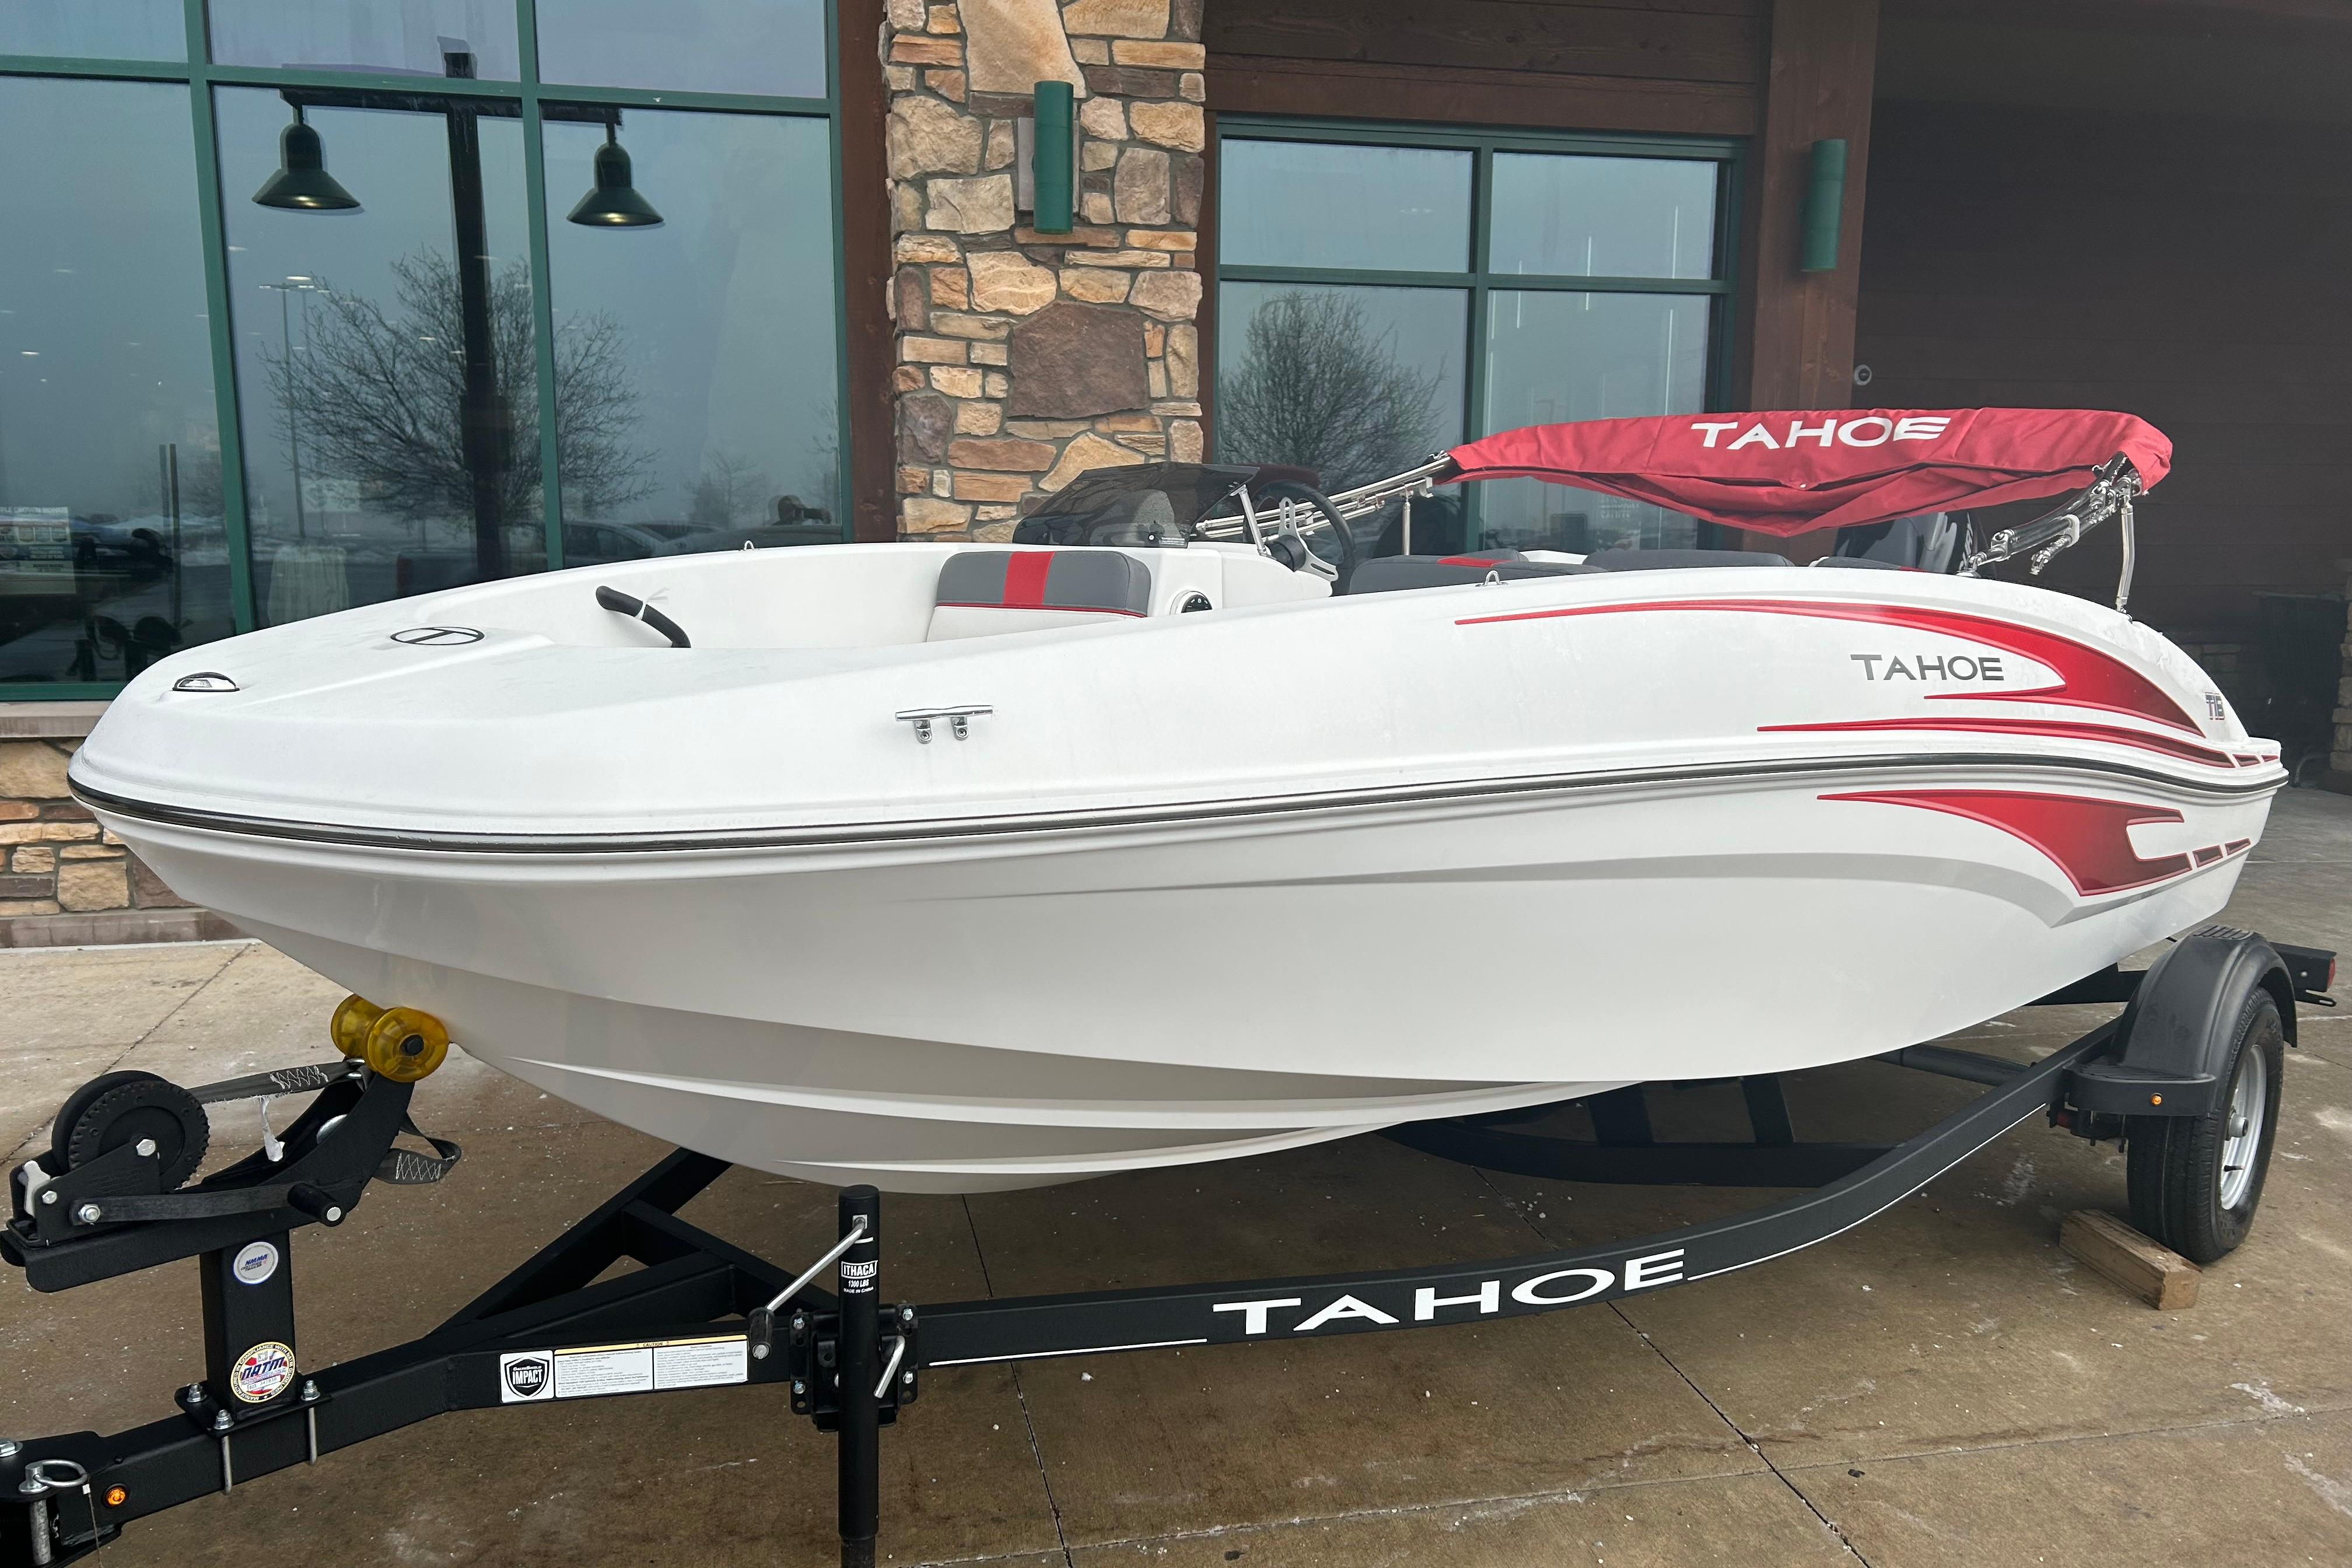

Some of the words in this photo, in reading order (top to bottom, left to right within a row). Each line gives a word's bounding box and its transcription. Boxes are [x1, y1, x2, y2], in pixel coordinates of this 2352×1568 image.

[1691, 416, 1951, 450] TAHOE
[1850, 654, 2004, 681] TAHOE
[844, 1264, 874, 1276] ITHACA
[859, 1279, 869, 1287] LBS
[1213, 1248, 1685, 1335] TAHOE
[239, 1344, 274, 1364] COMPLIANCE
[275, 1345, 288, 1353] WITH
[241, 1356, 285, 1381] NATM
[513, 1369, 542, 1385] IMPACT
